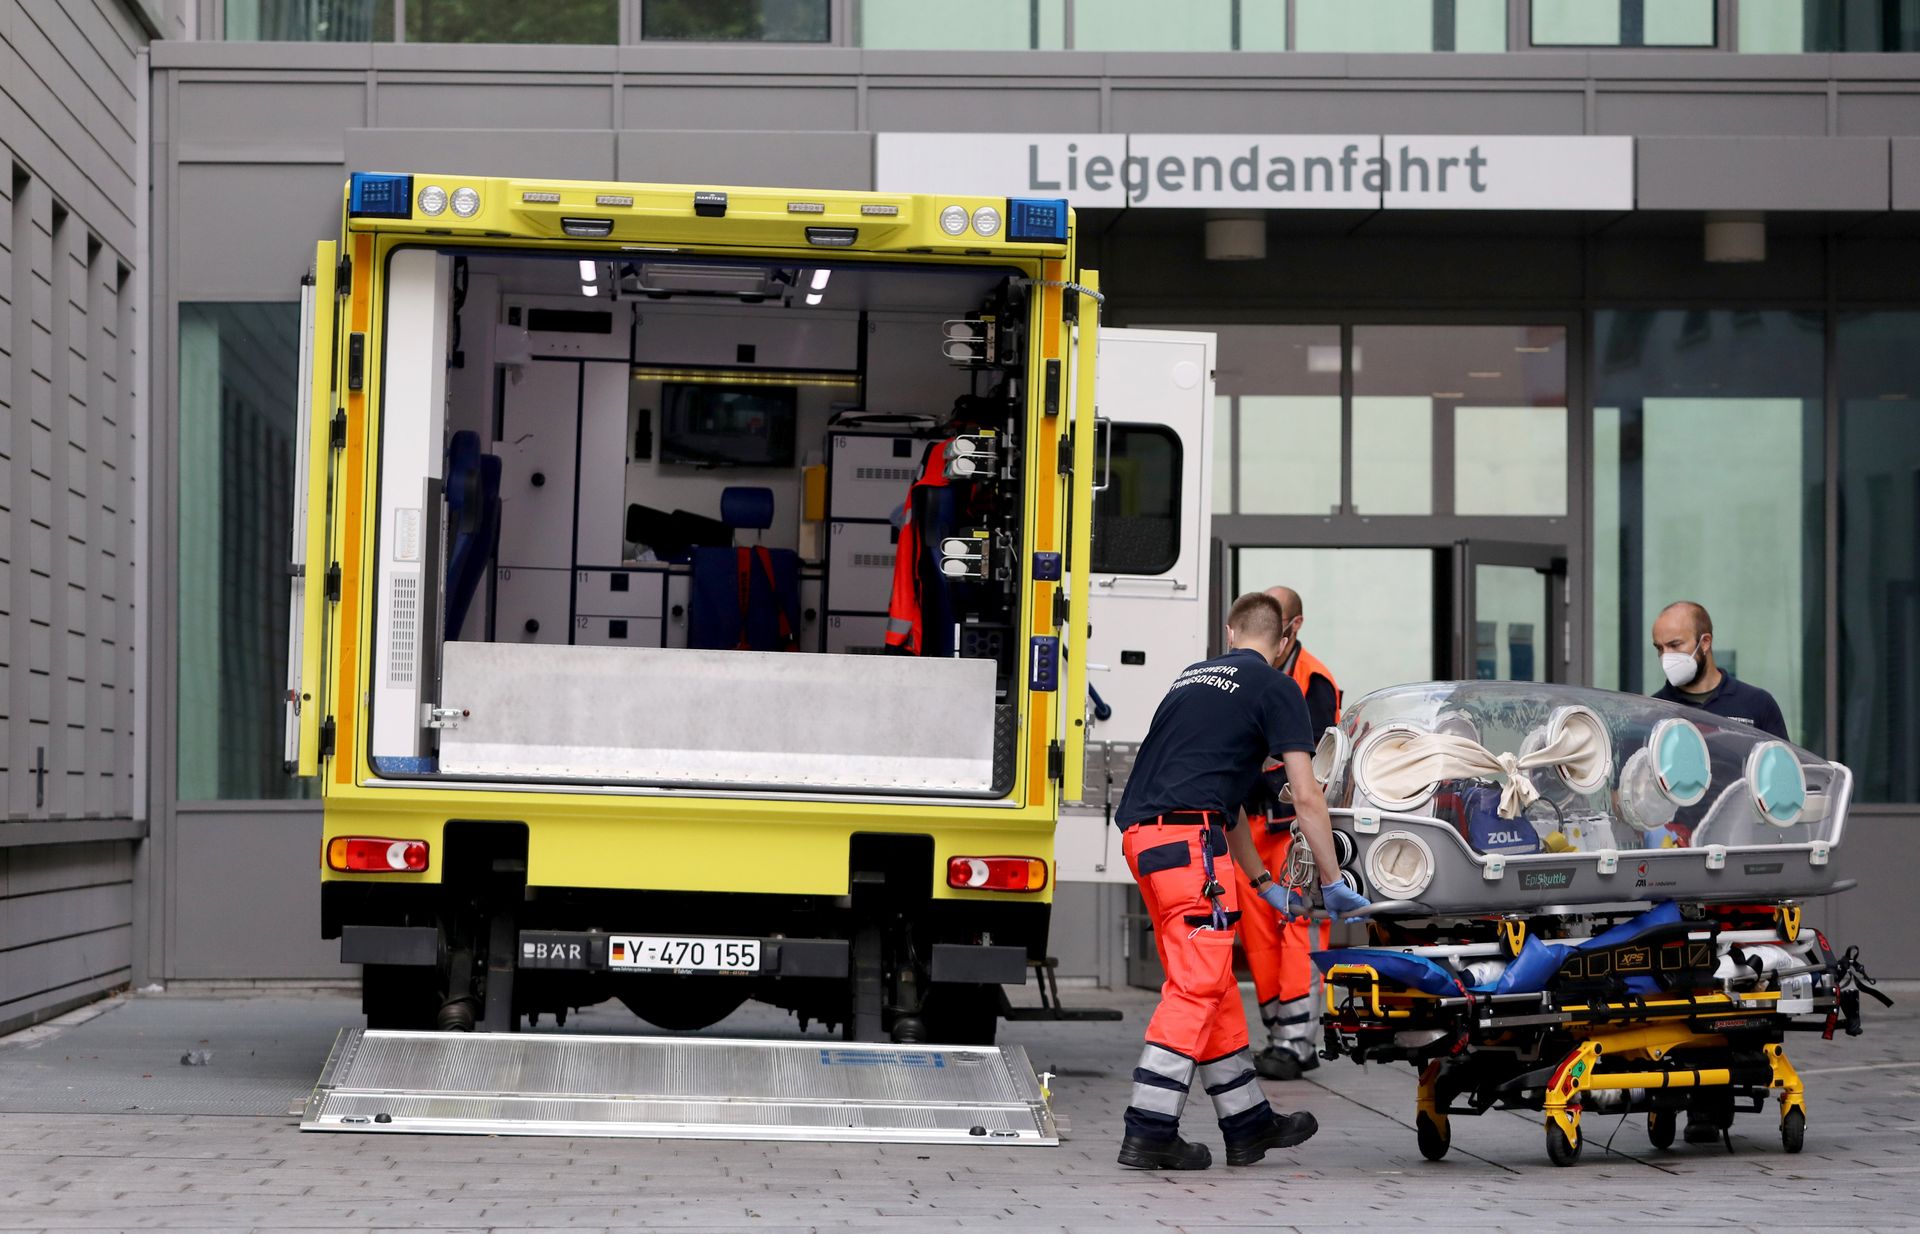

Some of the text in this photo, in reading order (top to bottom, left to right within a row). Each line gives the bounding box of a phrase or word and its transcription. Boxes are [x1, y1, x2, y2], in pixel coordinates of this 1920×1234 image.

[1028, 143, 1487, 202] Liegendanfahrt
[835, 437, 846, 448] 16
[833, 524, 844, 535] 17
[499, 569, 511, 581] 10
[579, 572, 588, 583] 11
[577, 617, 588, 629] 12
[829, 617, 841, 628] 18
[1488, 831, 1523, 844] ZOLL
[1525, 872, 1567, 887] EpiShuttle
[537, 943, 581, 960] BÄR
[714, 943, 755, 967] 155
[1621, 952, 1645, 965] XPS
